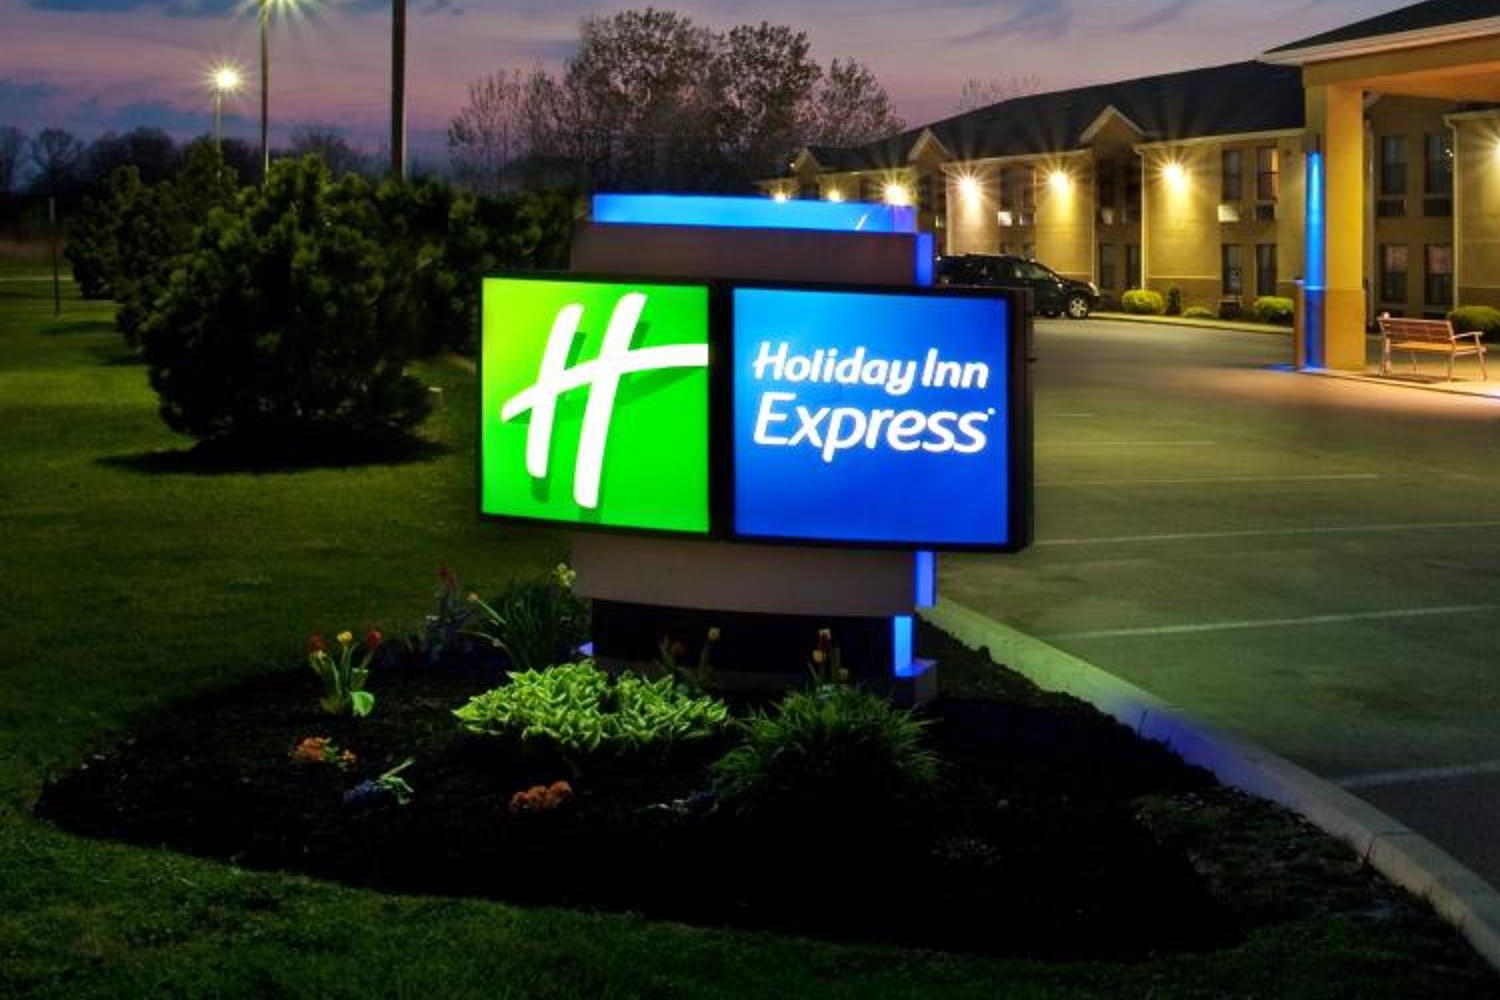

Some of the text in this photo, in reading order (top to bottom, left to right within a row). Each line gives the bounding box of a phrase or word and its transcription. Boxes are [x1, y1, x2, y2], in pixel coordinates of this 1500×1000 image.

[500, 292, 709, 509] H
[752, 340, 989, 396] Holiday Inn
[753, 391, 989, 463] Express
